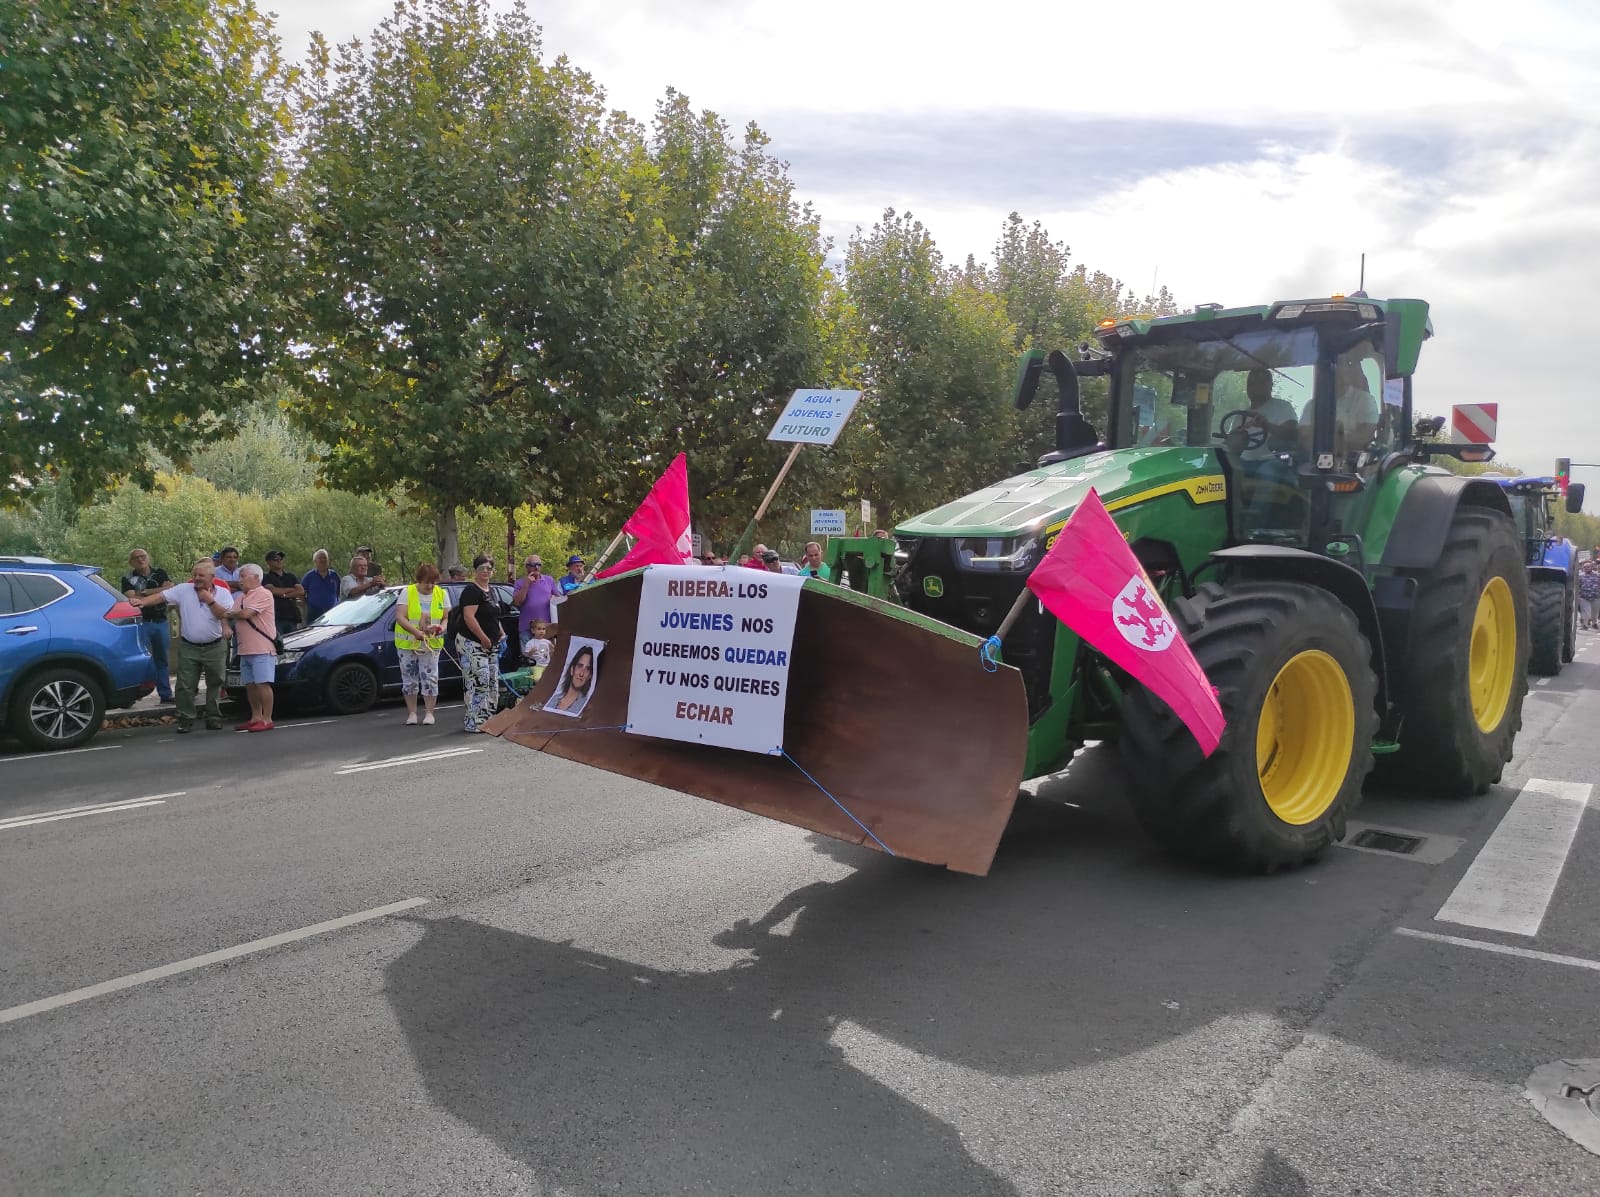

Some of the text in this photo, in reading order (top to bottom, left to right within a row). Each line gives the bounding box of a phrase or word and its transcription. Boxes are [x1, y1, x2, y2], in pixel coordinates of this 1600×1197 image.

[804, 396, 832, 404] AGUA
[779, 424, 831, 437] FUTURO
[1195, 482, 1223, 495] JOHN DEERE
[667, 580, 768, 598] RIBERA: LOS
[660, 609, 773, 633] JÓVENES NOS
[642, 641, 787, 666] QUEREMOS QUEDAR
[645, 669, 780, 696] Y TU NOS QUIERES
[675, 701, 734, 725] ECHAR
